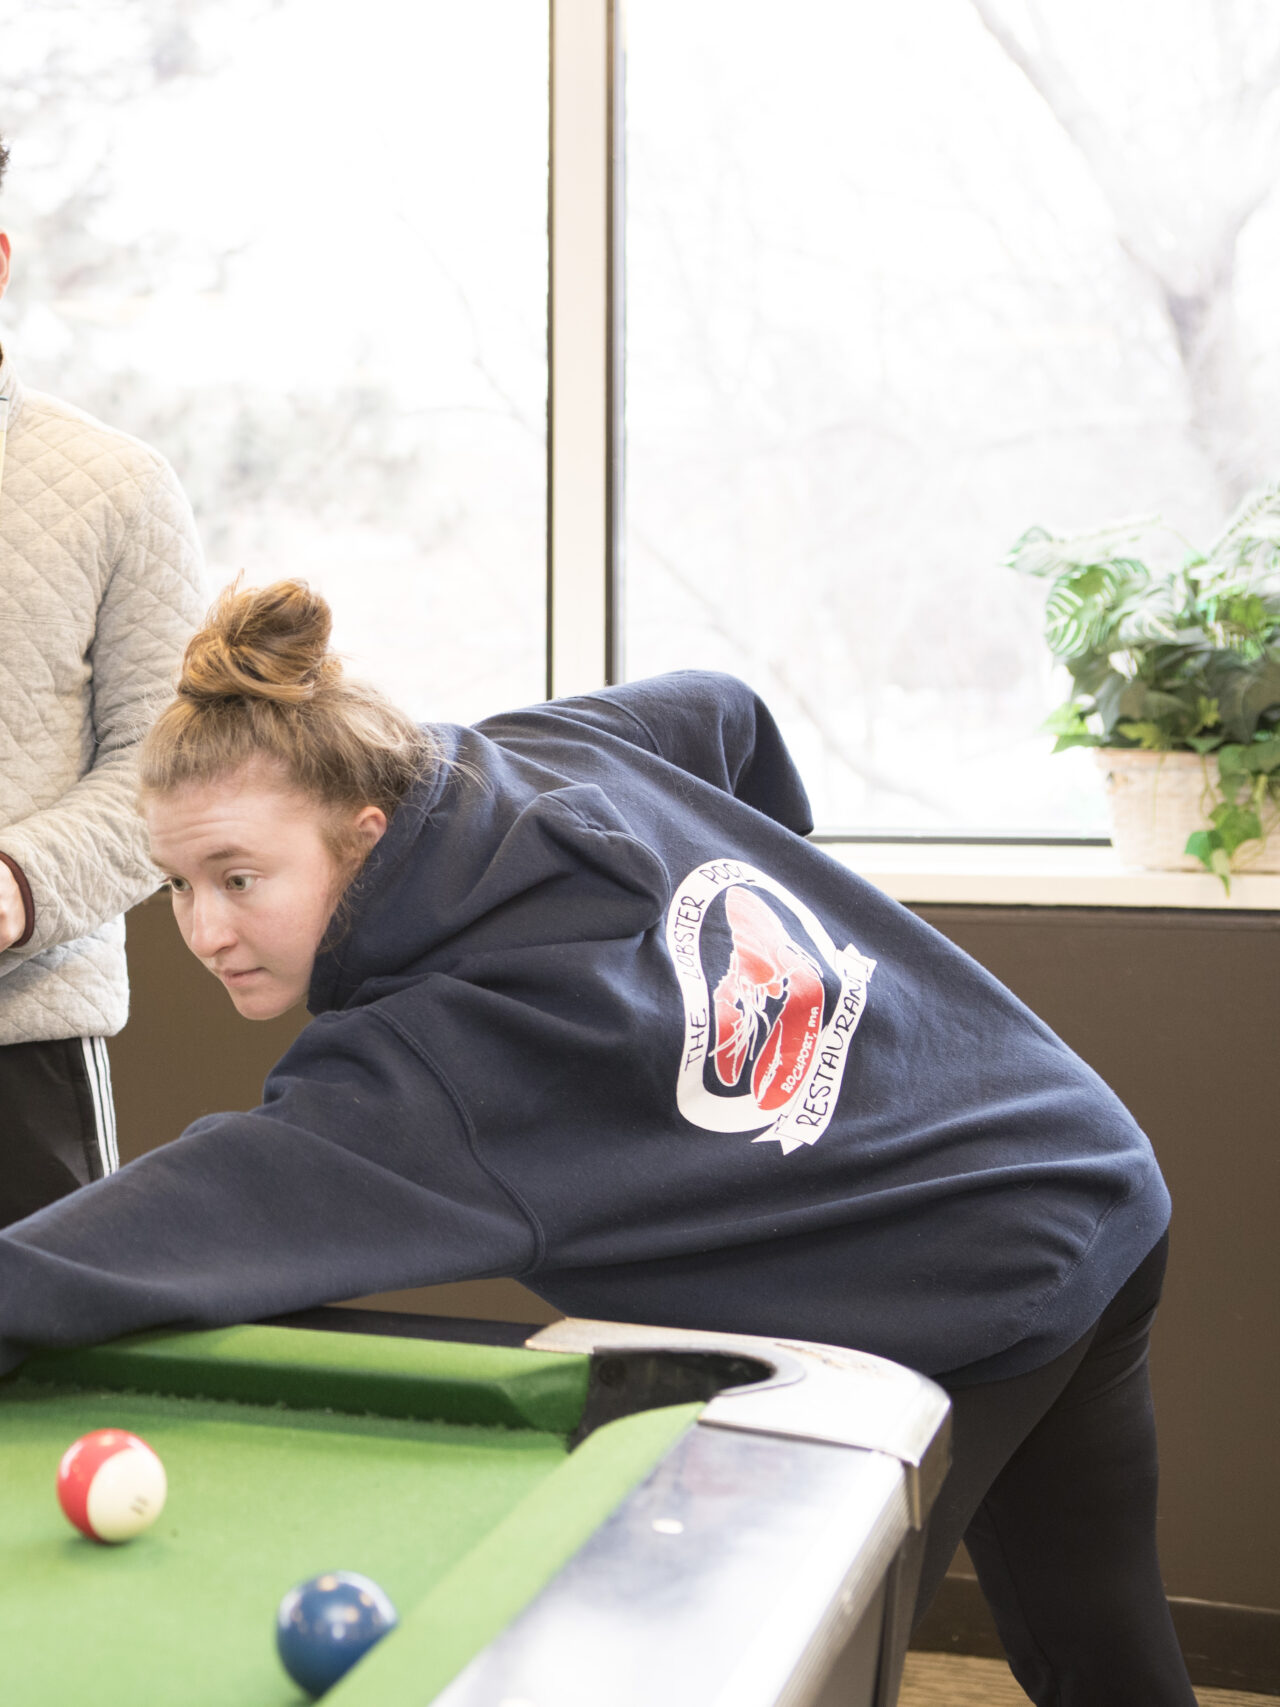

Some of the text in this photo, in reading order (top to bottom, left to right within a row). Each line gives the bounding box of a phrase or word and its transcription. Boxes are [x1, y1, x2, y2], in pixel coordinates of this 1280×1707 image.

[673, 895, 705, 980] LOBSTER
[683, 1007, 708, 1072] THE
[780, 1006, 820, 1094] ROCKPORT, MA
[795, 967, 863, 1128] RESTAURANT
